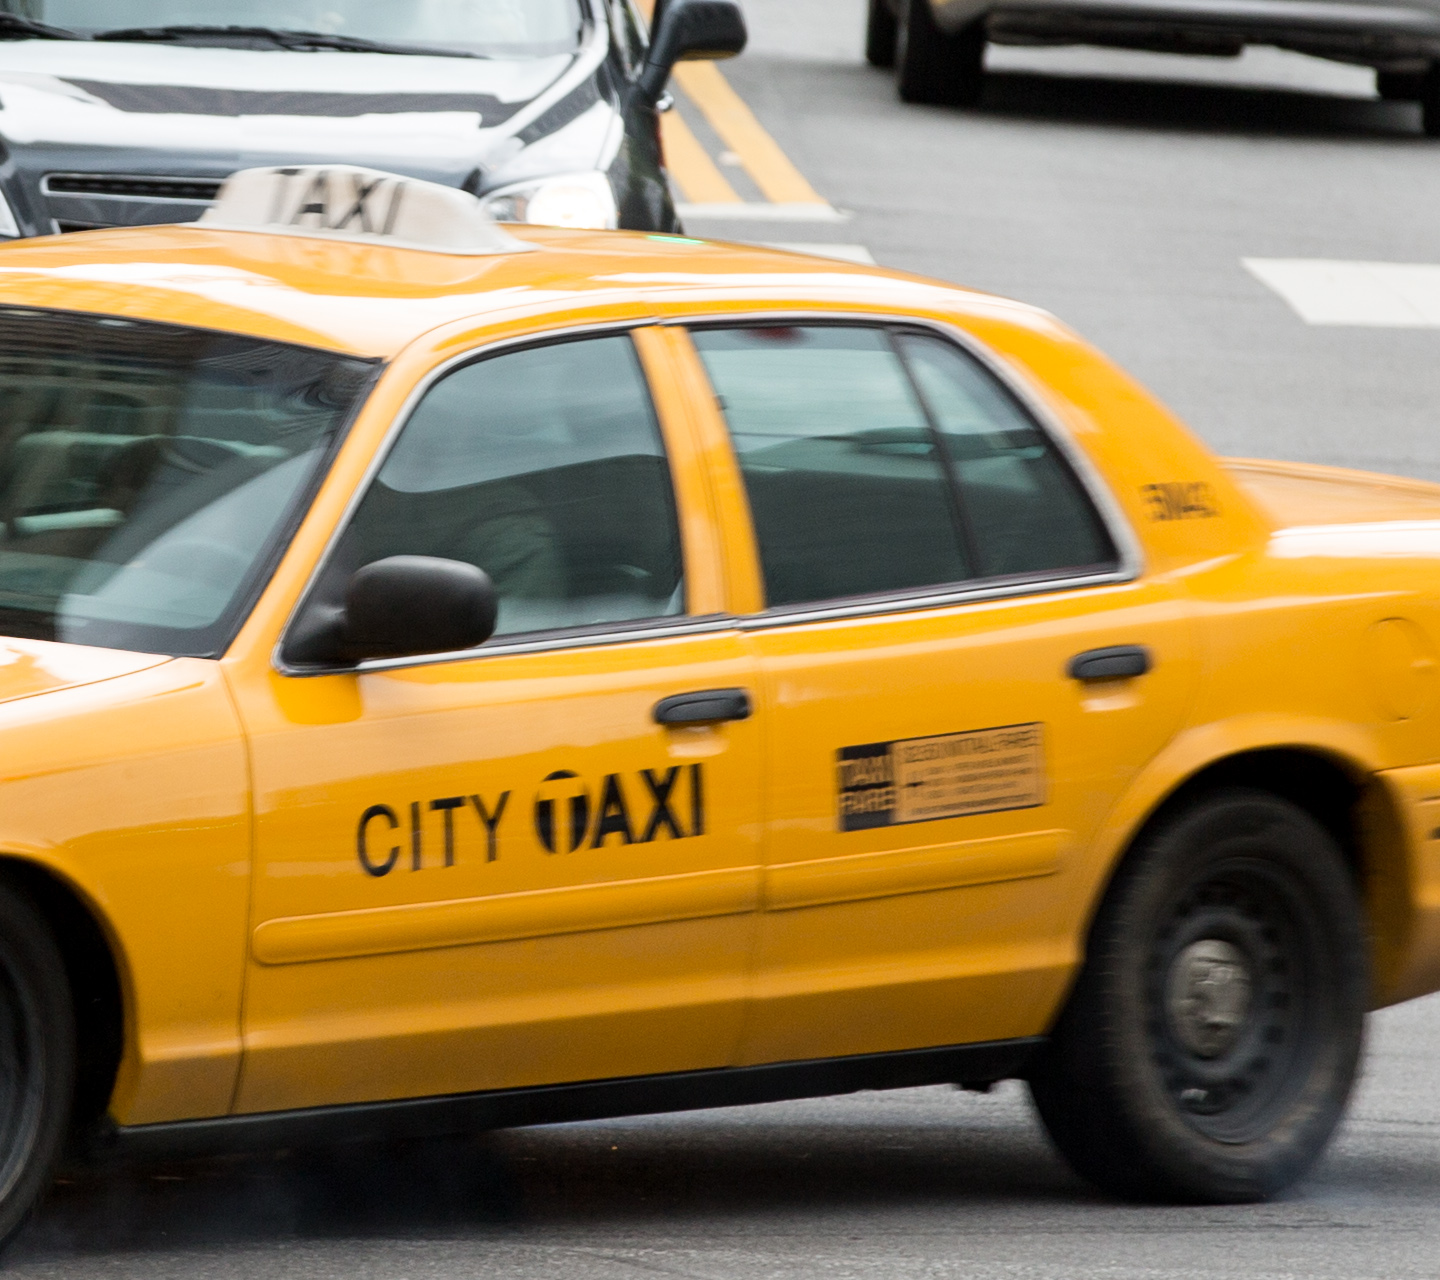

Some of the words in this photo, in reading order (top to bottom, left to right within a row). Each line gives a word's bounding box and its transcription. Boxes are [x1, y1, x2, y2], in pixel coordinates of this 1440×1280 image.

[269, 167, 406, 236] TAXI
[356, 789, 512, 878] CITY
[533, 762, 707, 855] TAXI
